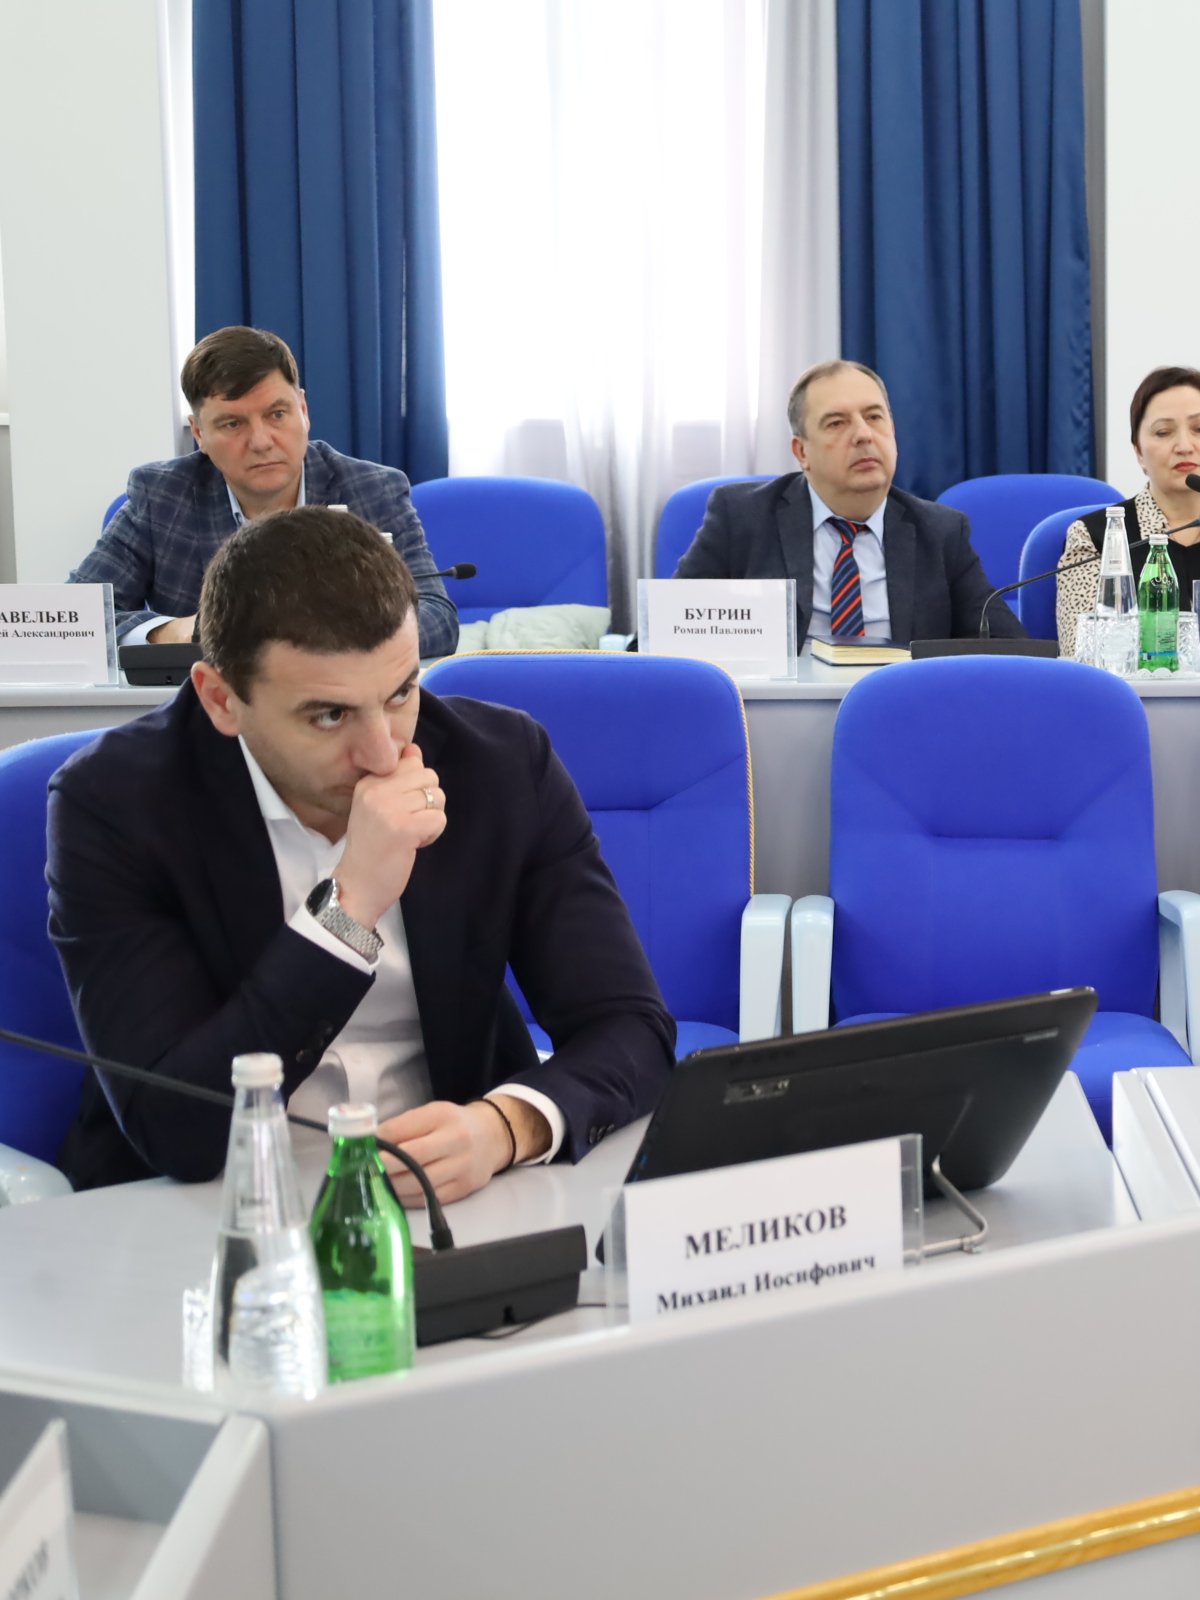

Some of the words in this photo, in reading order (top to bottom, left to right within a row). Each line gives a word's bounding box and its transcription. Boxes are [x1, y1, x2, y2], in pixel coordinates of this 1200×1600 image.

[684, 608, 752, 621] БУГРИН
[11, 629, 95, 639] Александрович
[673, 625, 707, 635] Роман
[710, 625, 763, 635] Павлович
[685, 1205, 847, 1259] МЕЛИКОВ
[657, 1282, 746, 1314] Михаил
[754, 1256, 876, 1293] Иосифович
